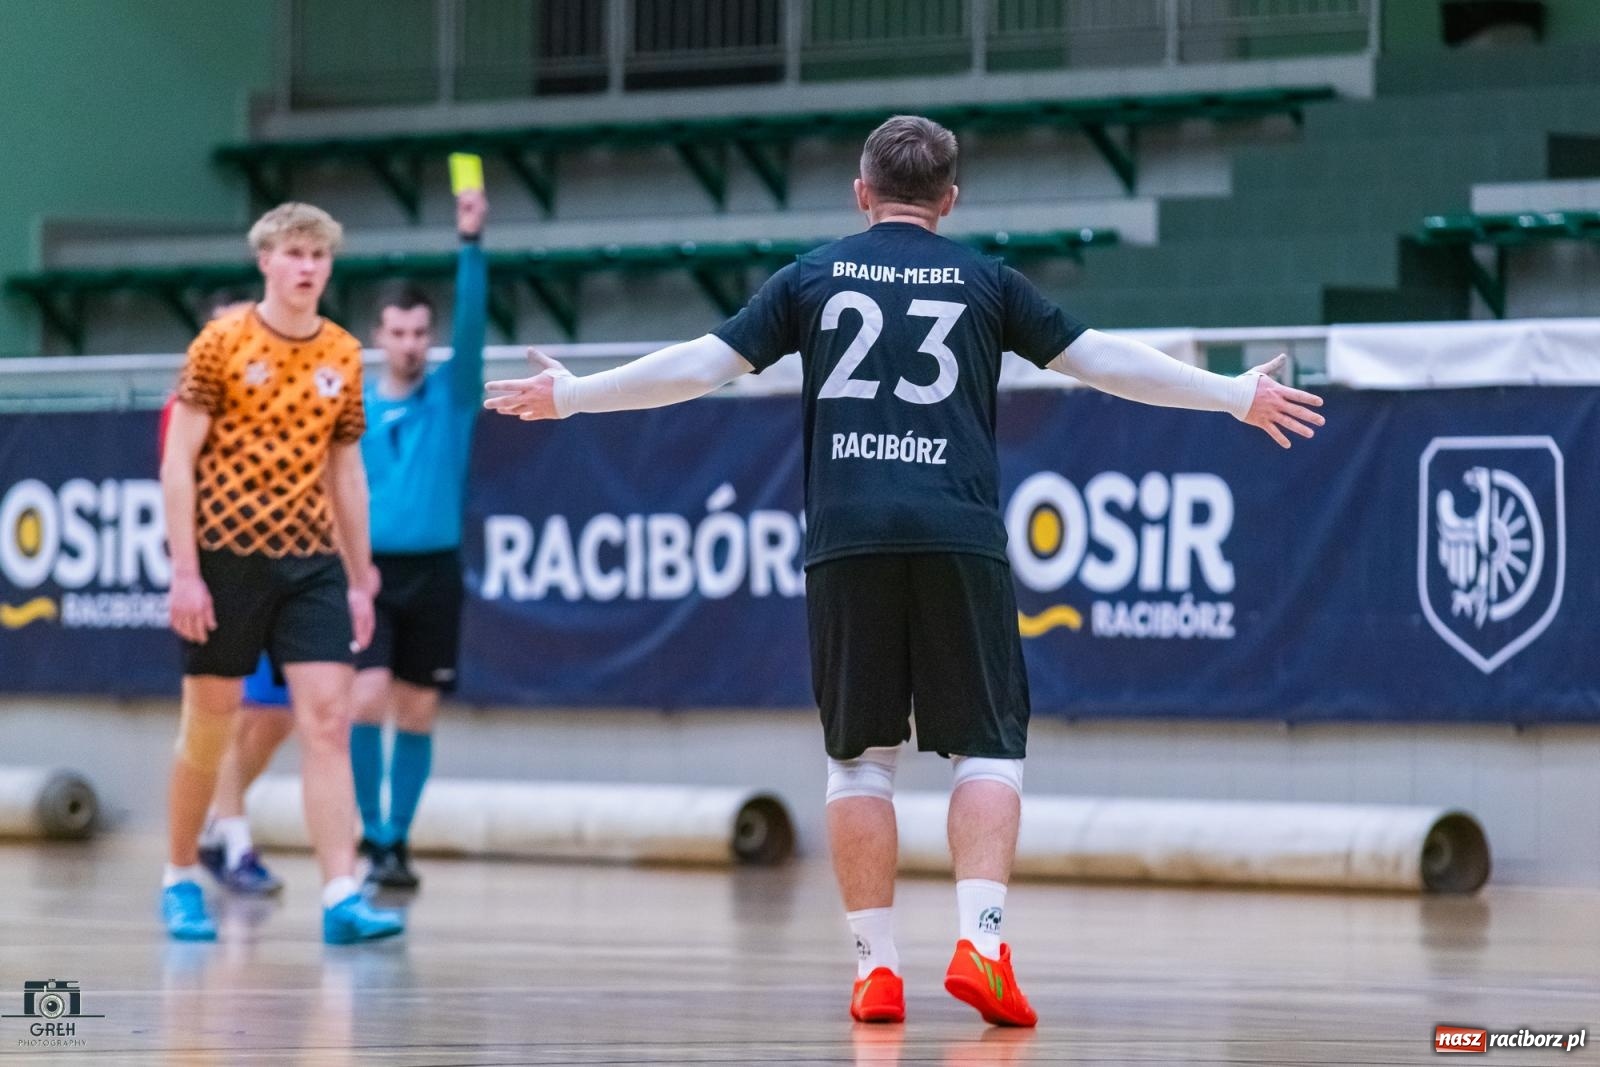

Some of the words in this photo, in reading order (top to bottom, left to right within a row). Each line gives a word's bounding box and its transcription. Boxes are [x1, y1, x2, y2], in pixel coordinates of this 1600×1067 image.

[832, 261, 965, 284] BRAUN-MEBEL
[817, 290, 968, 405] 23
[832, 430, 948, 465] RACIBÓRZ
[0, 478, 172, 589] OSiR
[480, 482, 806, 600] RACIBÓR
[1004, 470, 1236, 594] OSiR
[1091, 592, 1236, 639] RACIBÓRZ
